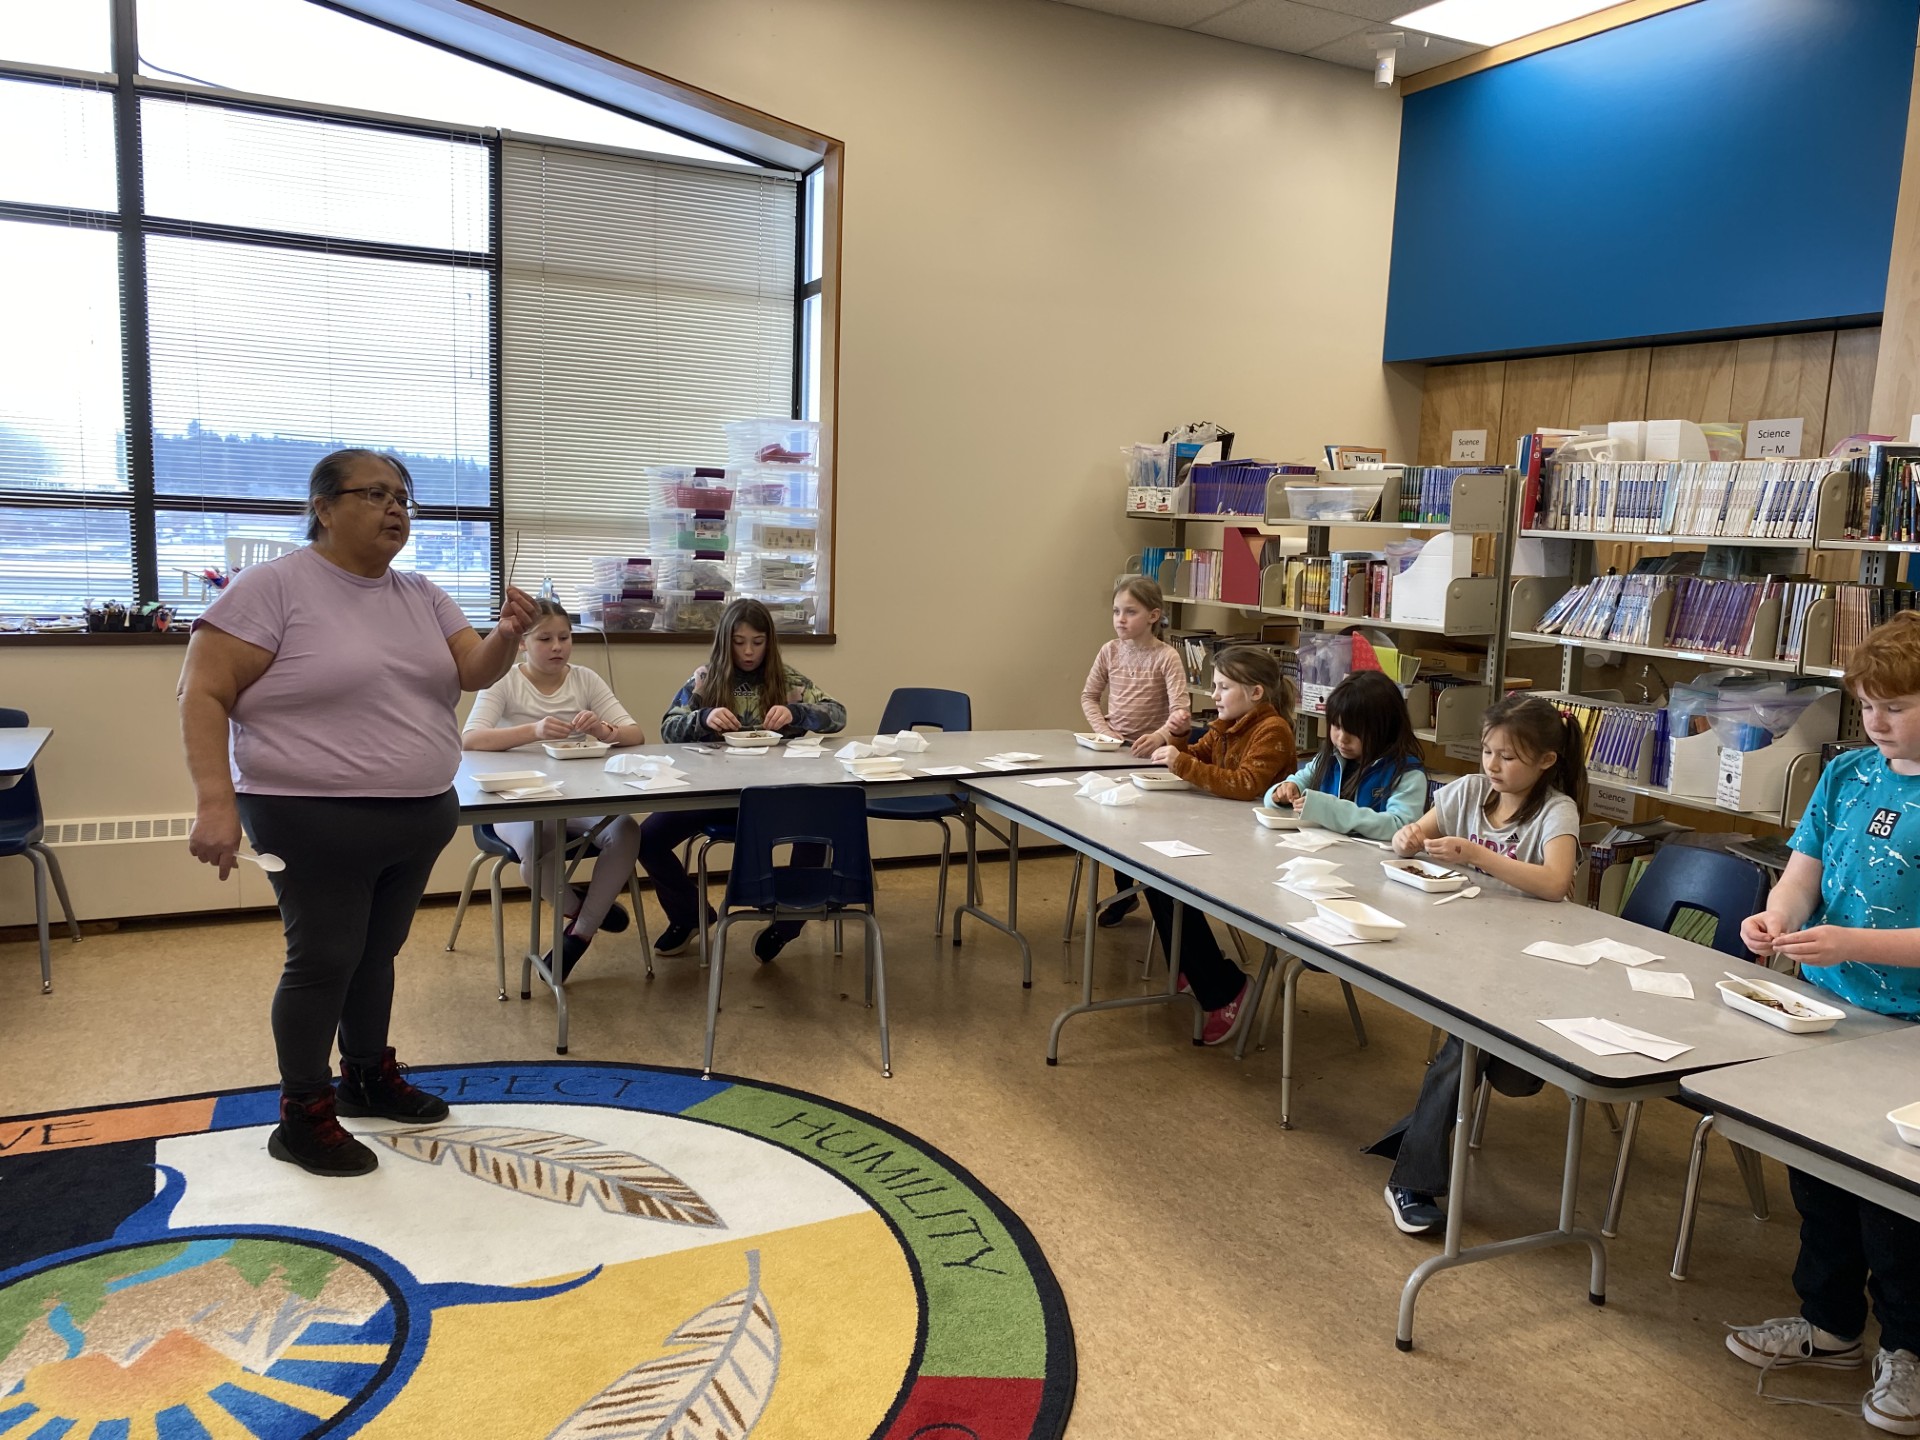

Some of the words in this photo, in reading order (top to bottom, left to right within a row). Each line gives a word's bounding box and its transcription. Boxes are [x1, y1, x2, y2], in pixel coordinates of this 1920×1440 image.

[1758, 429, 1791, 439] Science
[1458, 438, 1480, 446] Science
[1760, 445, 1766, 455] F
[1775, 445, 1785, 454] M
[1597, 789, 1626, 804] Science
[1873, 810, 1897, 825] AE
[1868, 821, 1891, 837] RO
[411, 1074, 652, 1099] SPECT
[770, 1111, 1008, 1275] HUMILITY
